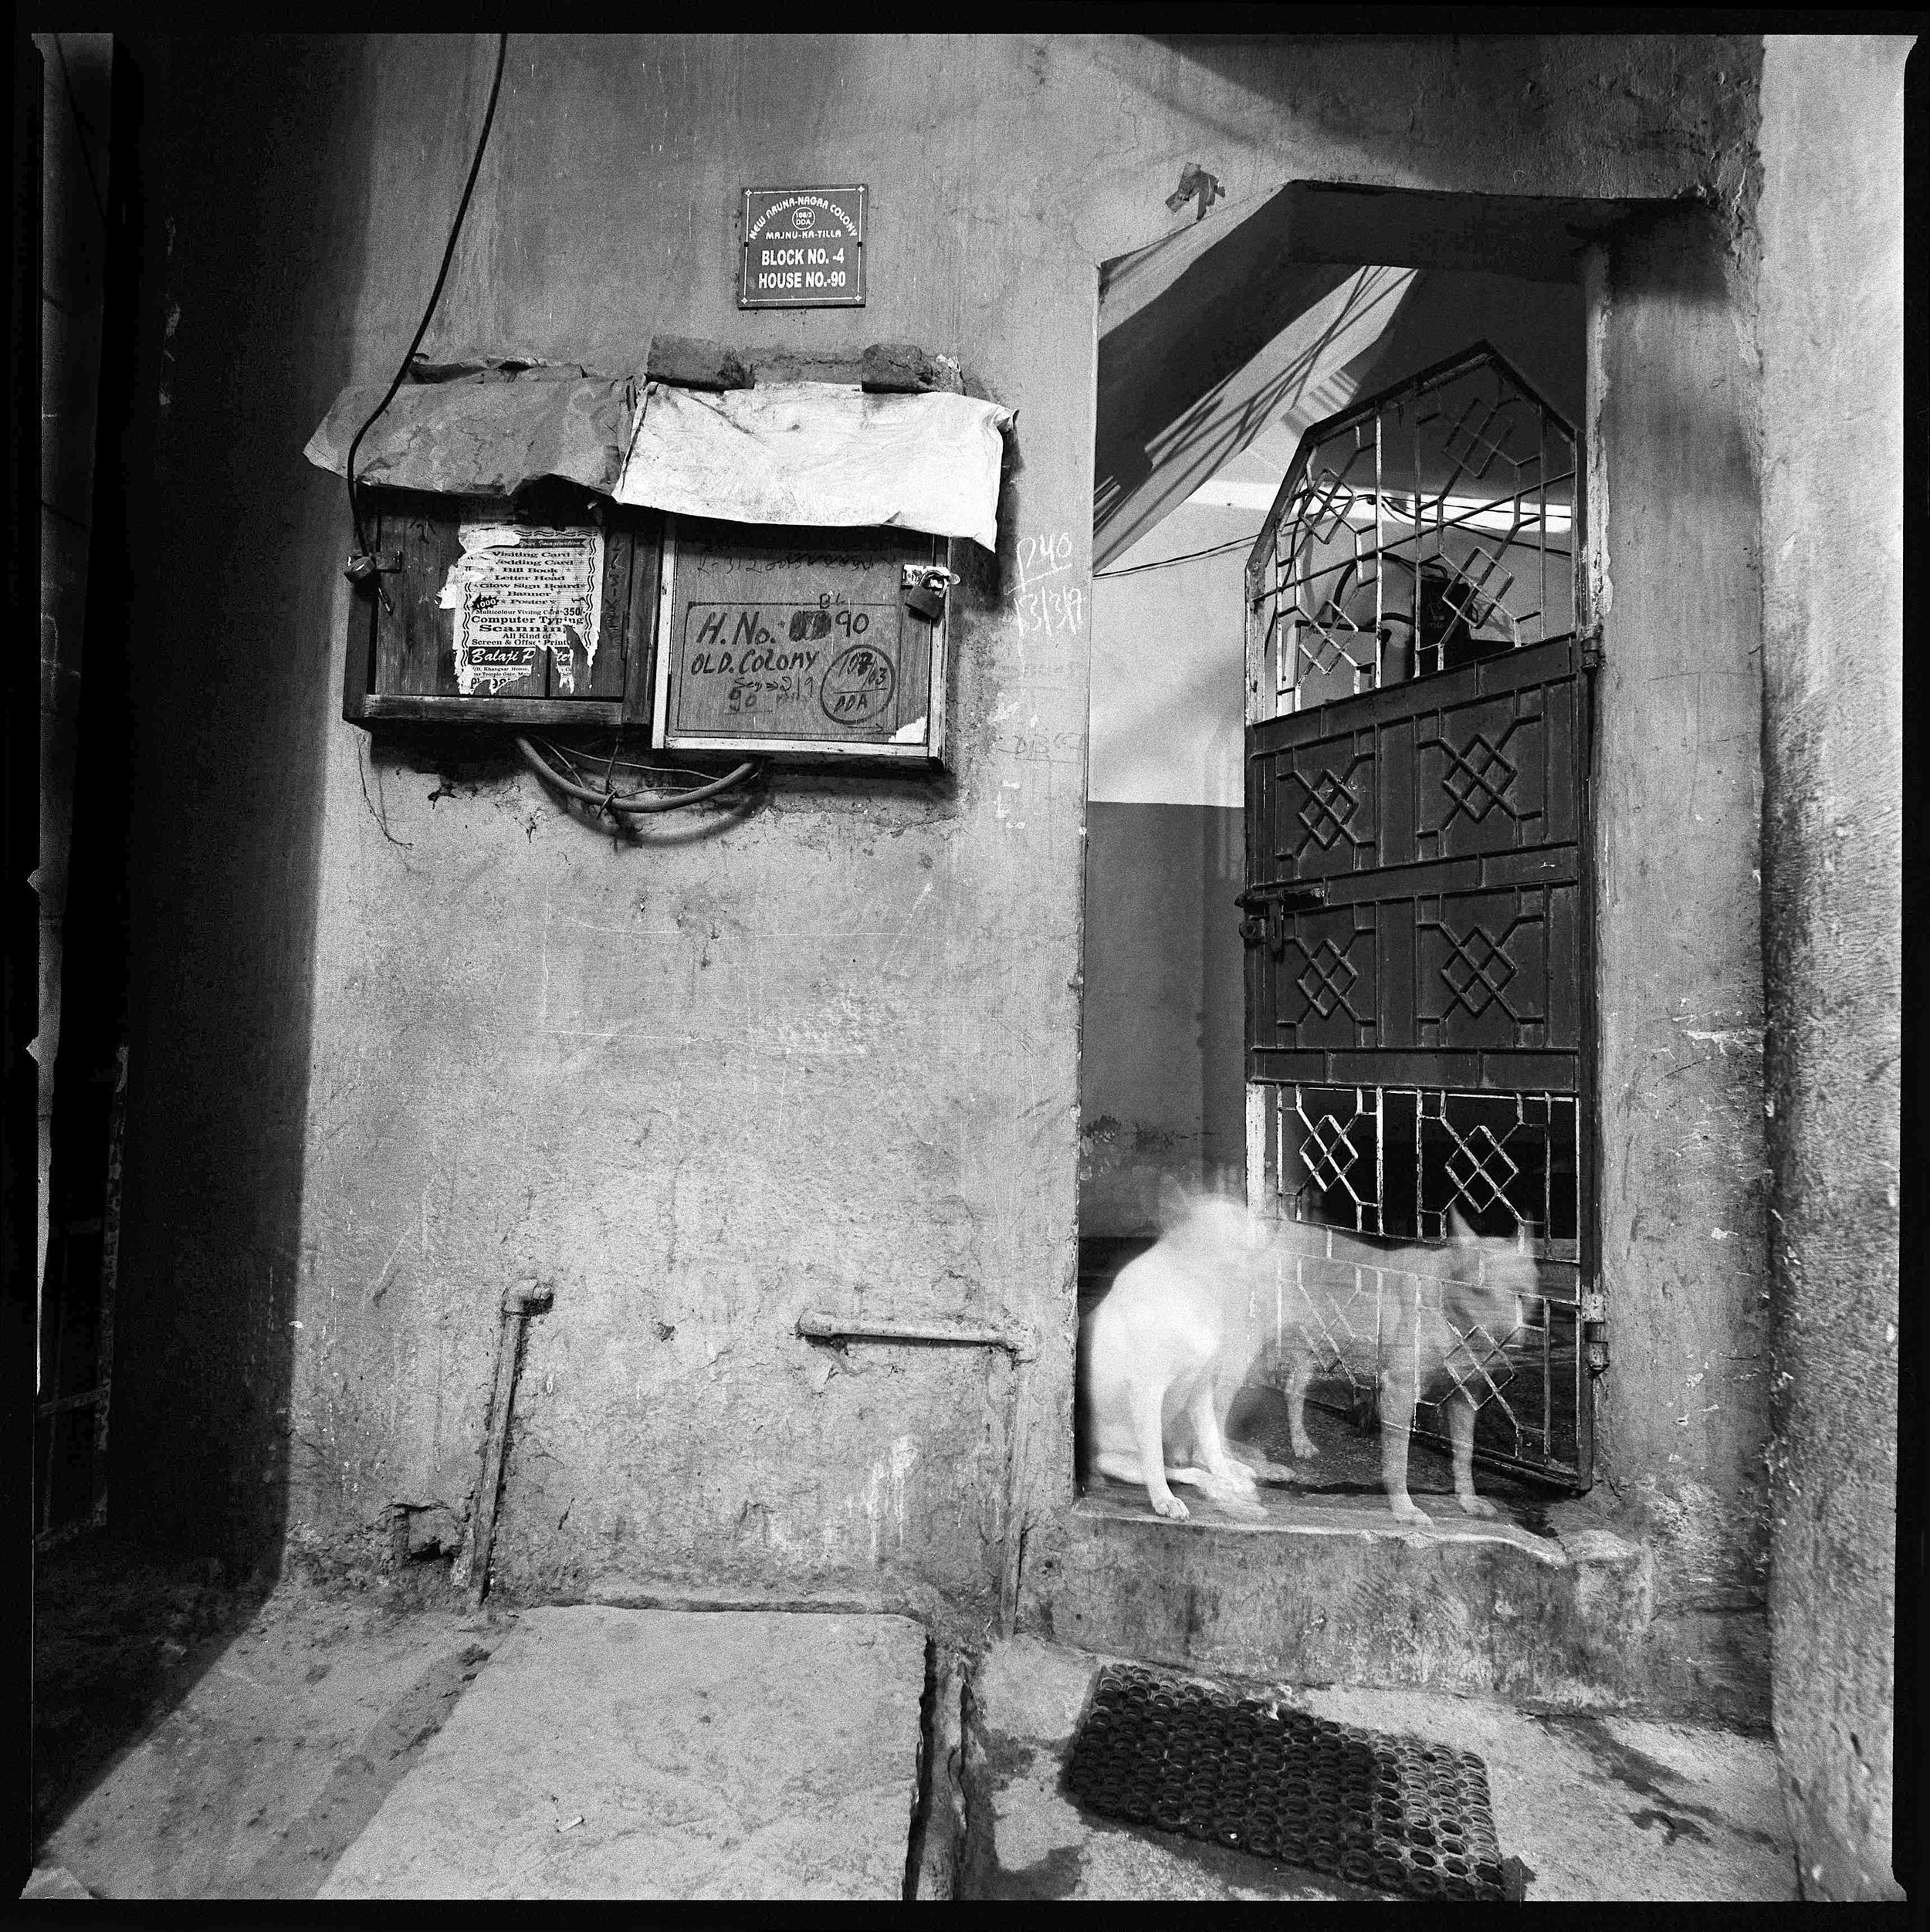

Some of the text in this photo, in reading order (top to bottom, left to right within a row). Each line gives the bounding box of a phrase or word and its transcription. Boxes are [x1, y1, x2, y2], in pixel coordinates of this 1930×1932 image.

[749, 216, 767, 240] NEW
[829, 204, 858, 237] COLONY
[765, 229, 842, 240] MAJNU-KA-TILLA
[761, 249, 804, 266] BLOCK
[808, 248, 830, 265] NO.
[758, 272, 802, 289] HOUSE
[513, 582, 540, 590] Sign
[471, 616, 536, 624] Computer
[479, 624, 567, 633] Scannin
[835, 610, 870, 638] 90
[471, 648, 518, 665] Balaji
